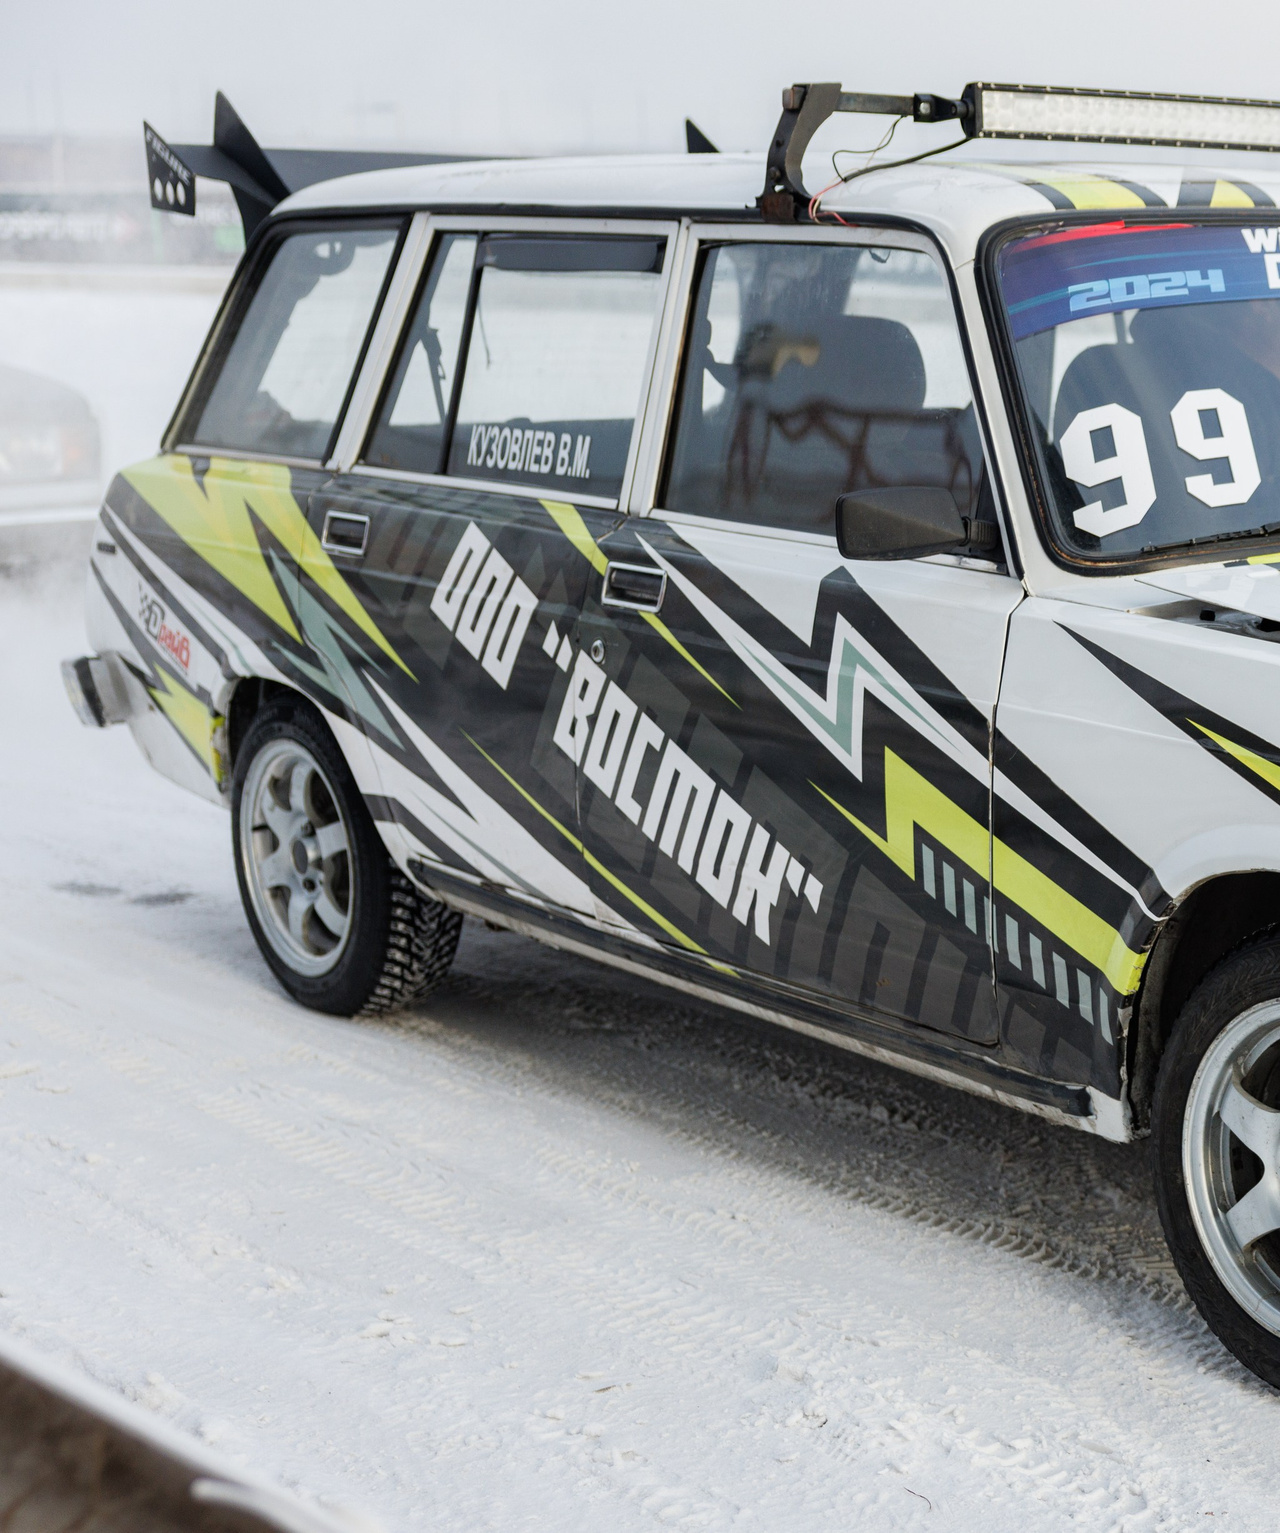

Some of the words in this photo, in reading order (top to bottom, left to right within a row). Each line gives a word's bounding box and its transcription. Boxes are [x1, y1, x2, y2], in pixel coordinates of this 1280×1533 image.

[1068, 269, 1226, 312] 2024
[467, 424, 556, 474] КУЗОВЛЕВ
[555, 432, 592, 479] В.М.
[430, 520, 539, 691] ООО
